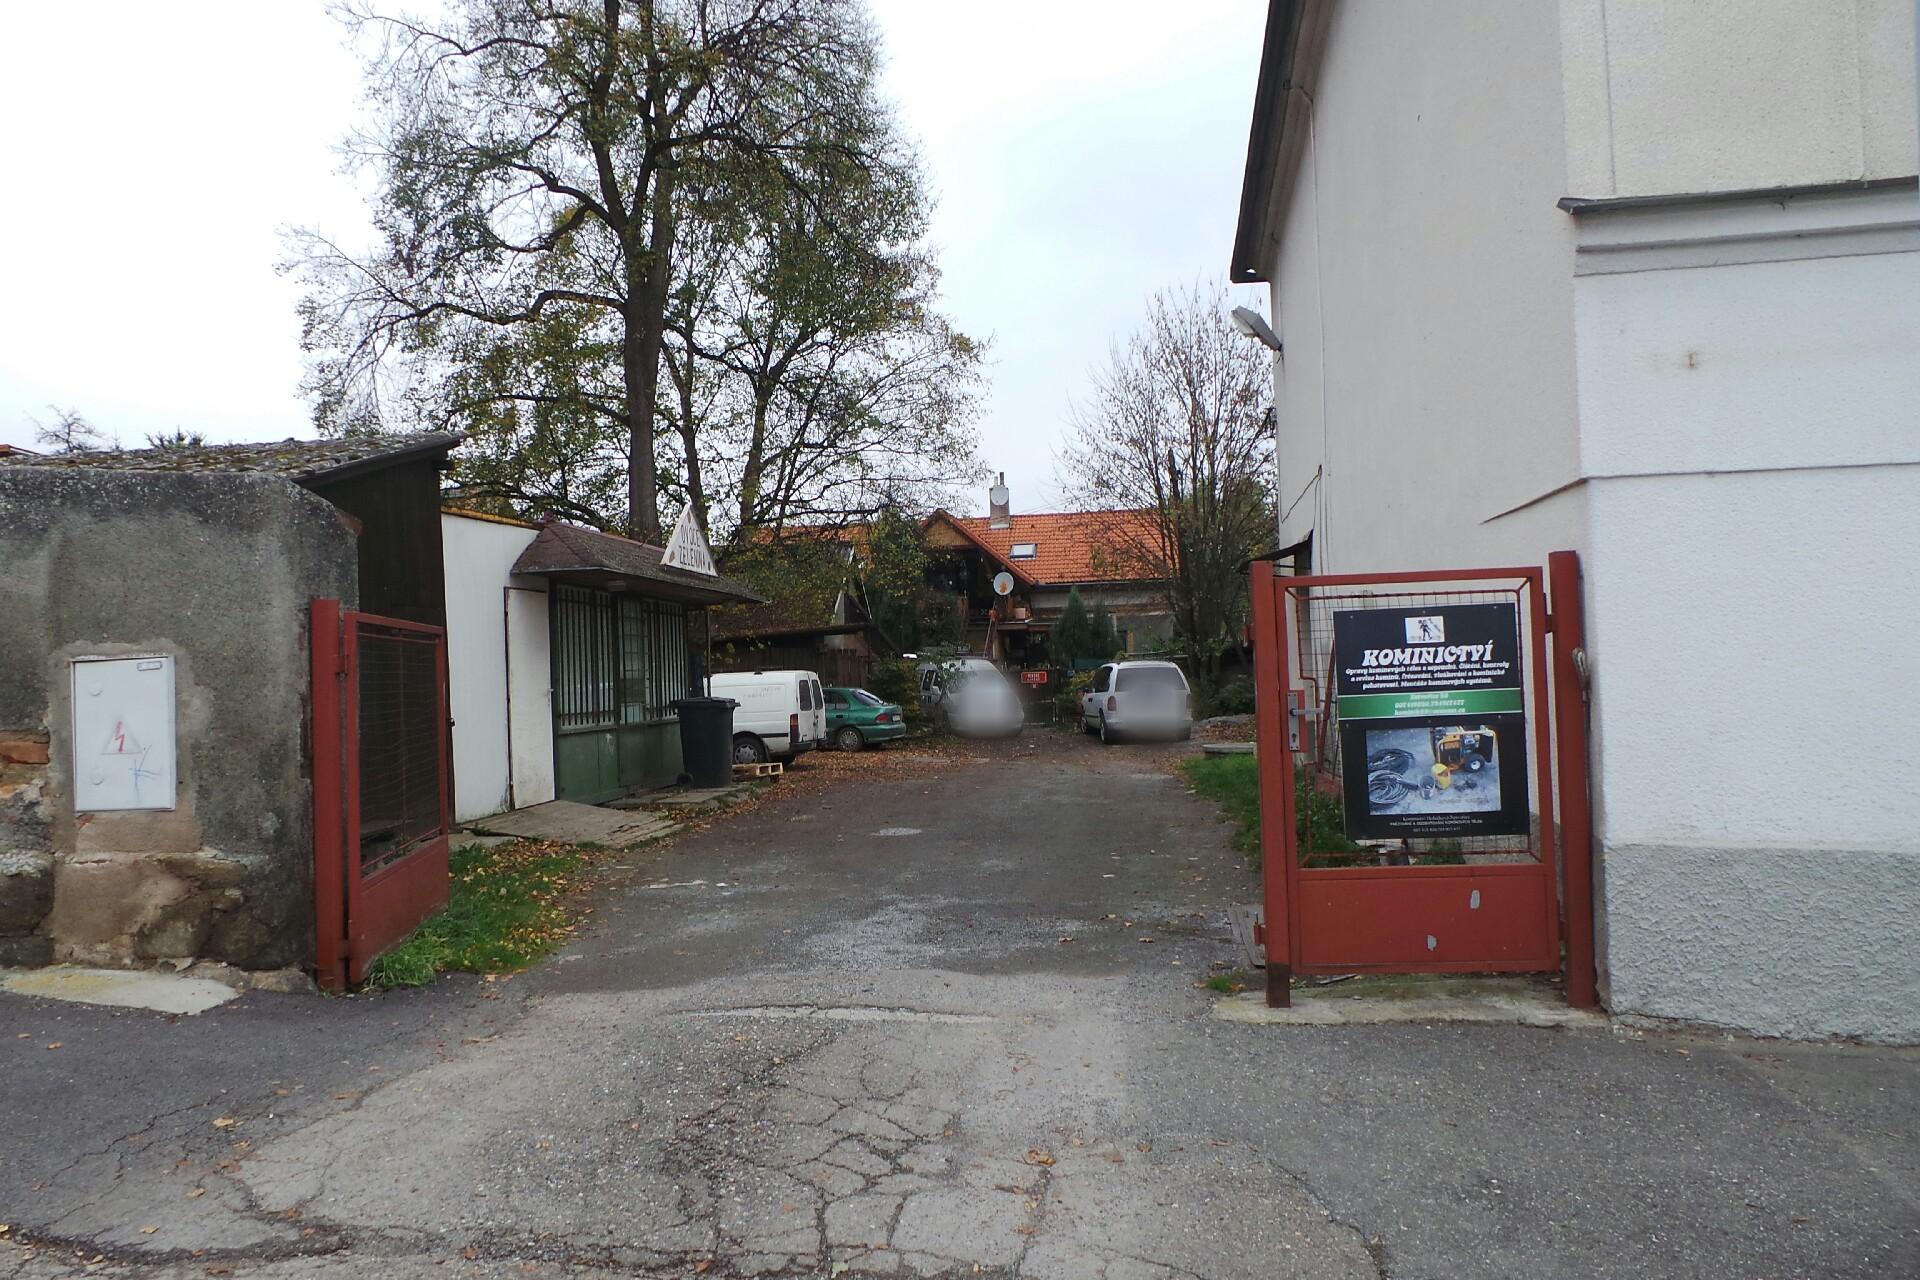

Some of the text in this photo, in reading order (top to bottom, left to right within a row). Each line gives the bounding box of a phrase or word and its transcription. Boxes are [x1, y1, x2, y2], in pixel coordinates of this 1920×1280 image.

[681, 524, 700, 547] OVOCE
[679, 545, 705, 569] ZELENINA
[1362, 640, 1493, 666] KOMINICTVÍ
